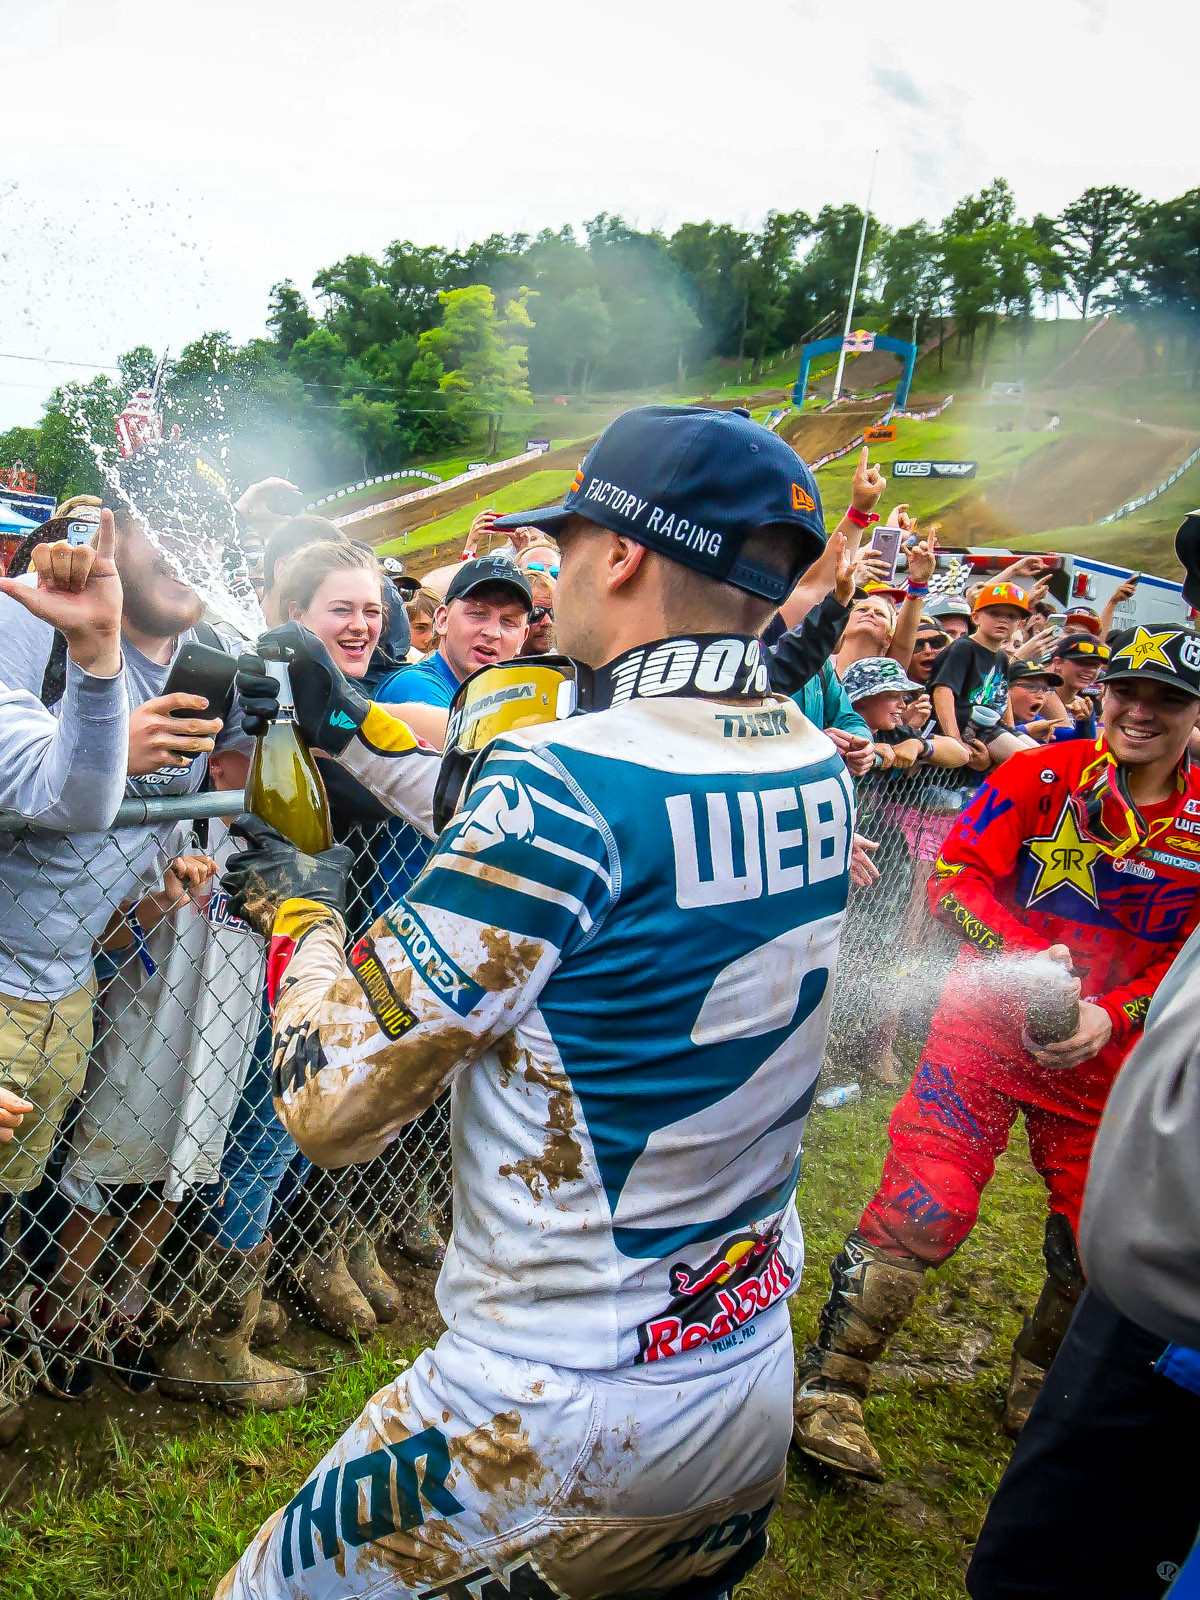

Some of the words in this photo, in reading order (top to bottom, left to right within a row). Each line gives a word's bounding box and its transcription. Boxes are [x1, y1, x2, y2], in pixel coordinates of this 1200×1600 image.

[584, 478, 648, 521] FACTORY
[647, 506, 723, 557] RACING
[610, 638, 768, 709] 100%
[714, 709, 790, 738] THOR
[387, 901, 469, 1005] MOTOREX
[645, 1289, 737, 1363] Red
[732, 1249, 792, 1325] Bull
[711, 1325, 757, 1354] PRIME_PRO
[282, 1426, 467, 1578] THOR
